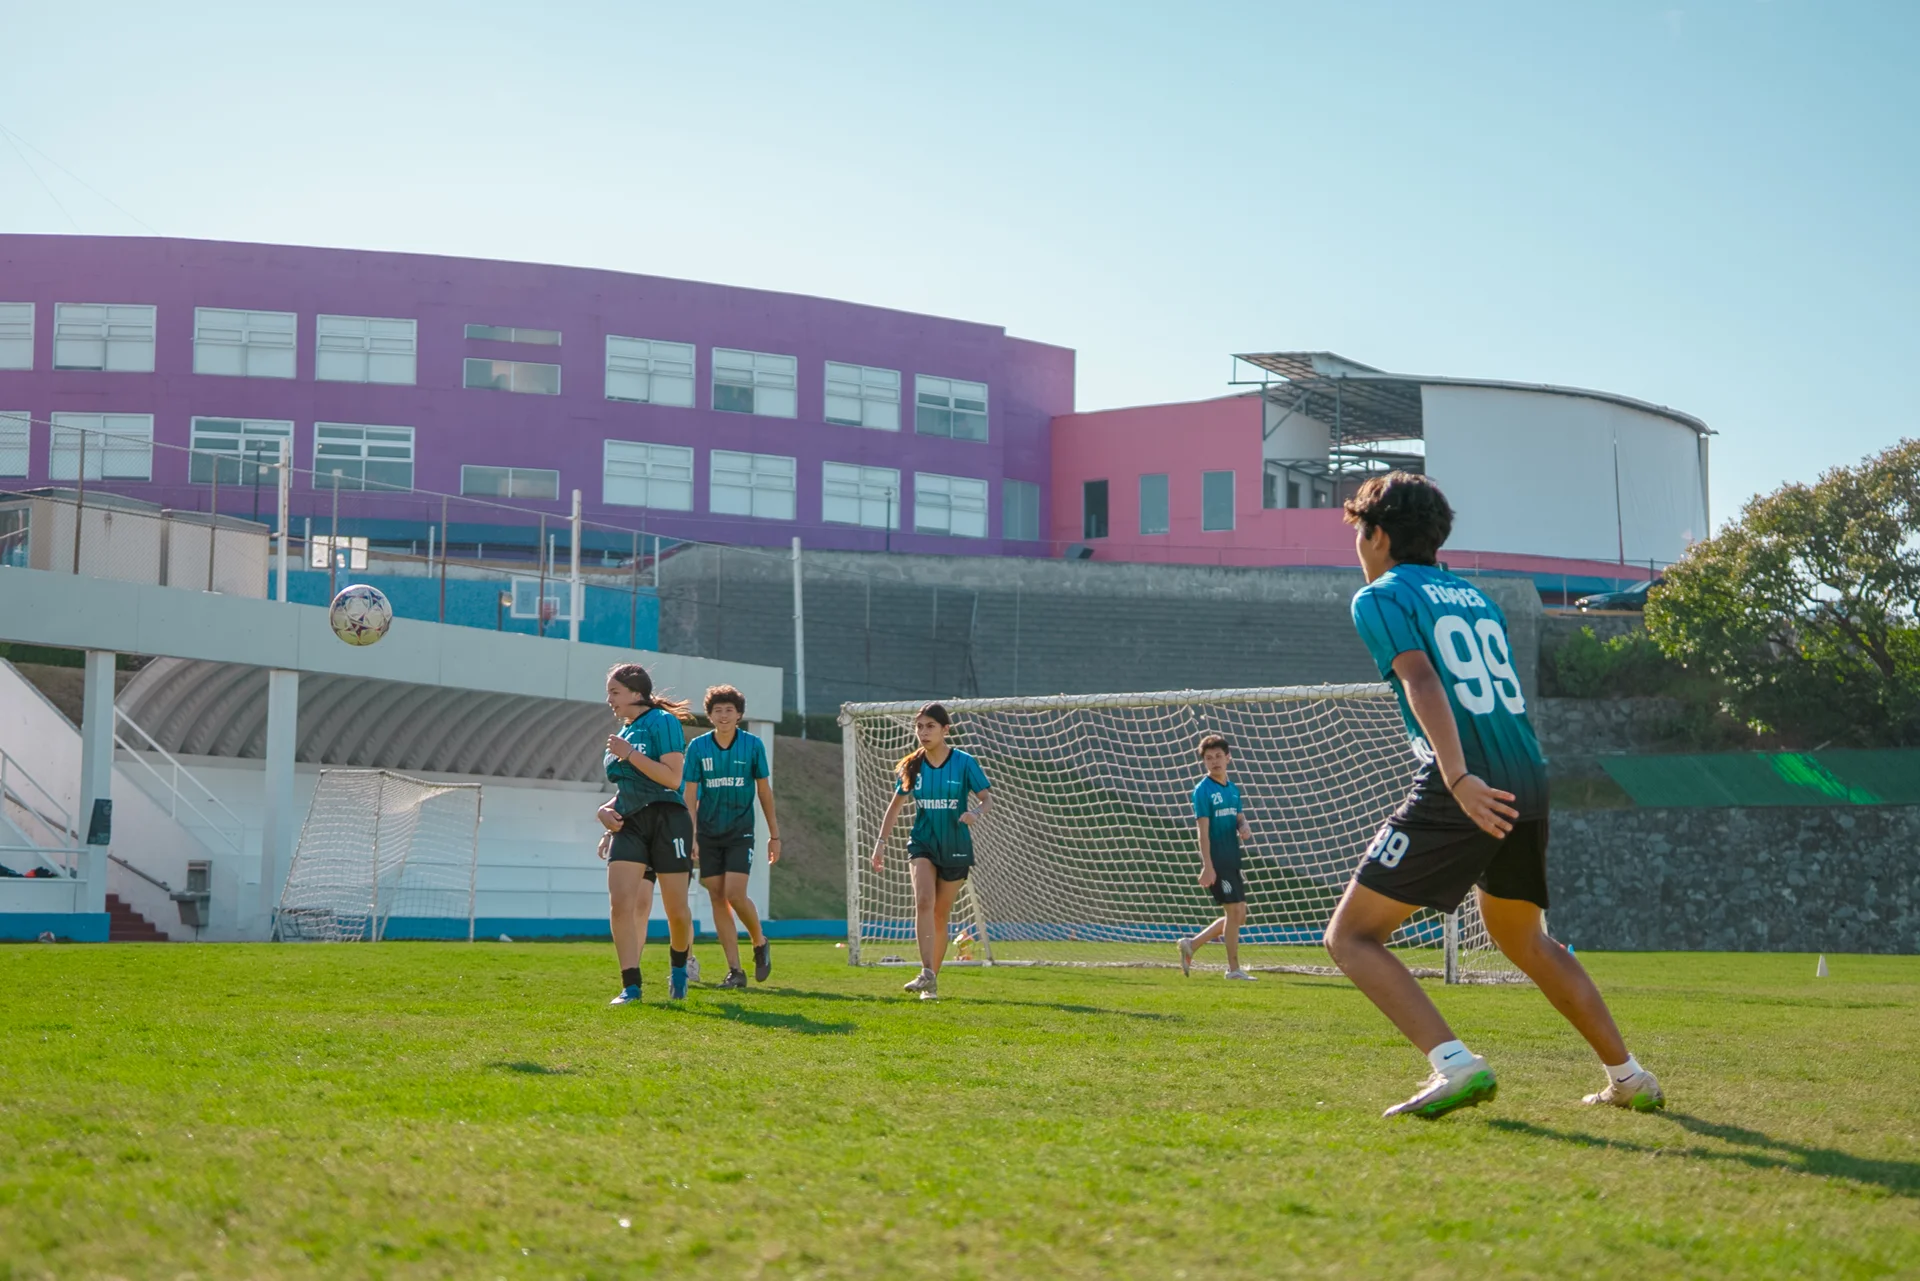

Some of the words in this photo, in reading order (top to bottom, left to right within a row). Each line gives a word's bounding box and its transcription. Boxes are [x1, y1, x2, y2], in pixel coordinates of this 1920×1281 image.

[1421, 584, 1486, 607] FLORES
[1434, 615, 1525, 714] 99
[1367, 825, 1410, 868] 99
